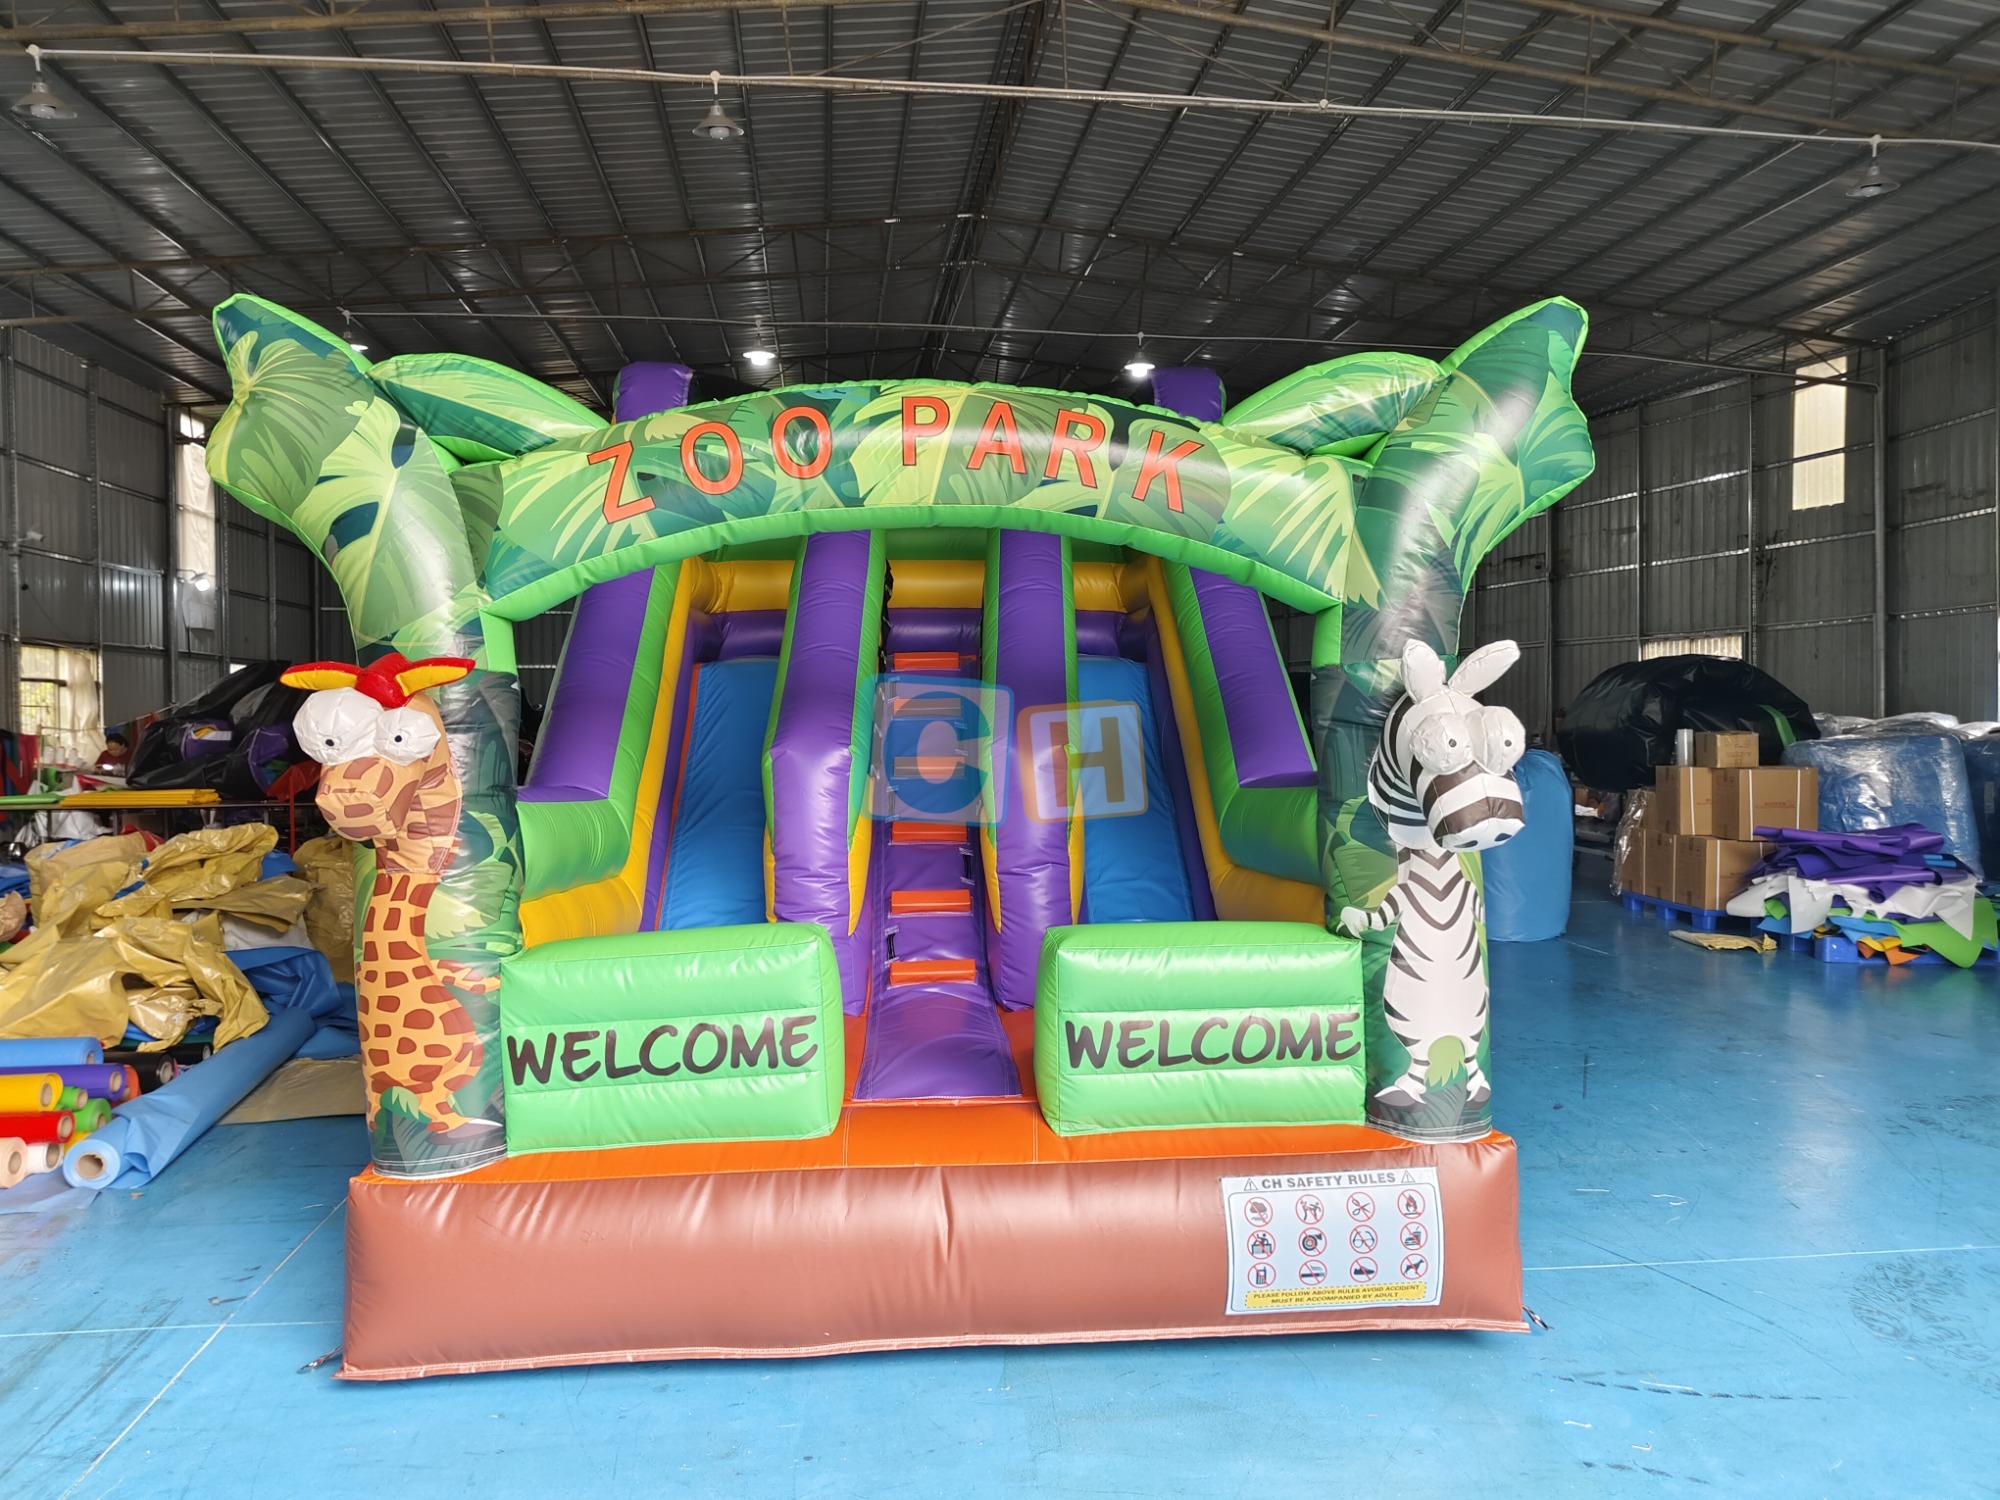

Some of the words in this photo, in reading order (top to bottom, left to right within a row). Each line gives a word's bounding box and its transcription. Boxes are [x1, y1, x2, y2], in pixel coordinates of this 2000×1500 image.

[587, 406, 834, 524] ZOO
[901, 396, 1204, 513] PARK
[506, 1014, 818, 1086] WELCOME
[1066, 1010, 1362, 1071] WELCOME
[1262, 1178, 1282, 1189] CH
[1287, 1175, 1342, 1188] SAFETY
[1348, 1172, 1396, 1185] RULES
[1306, 1294, 1360, 1302] ACCOMPANIED
